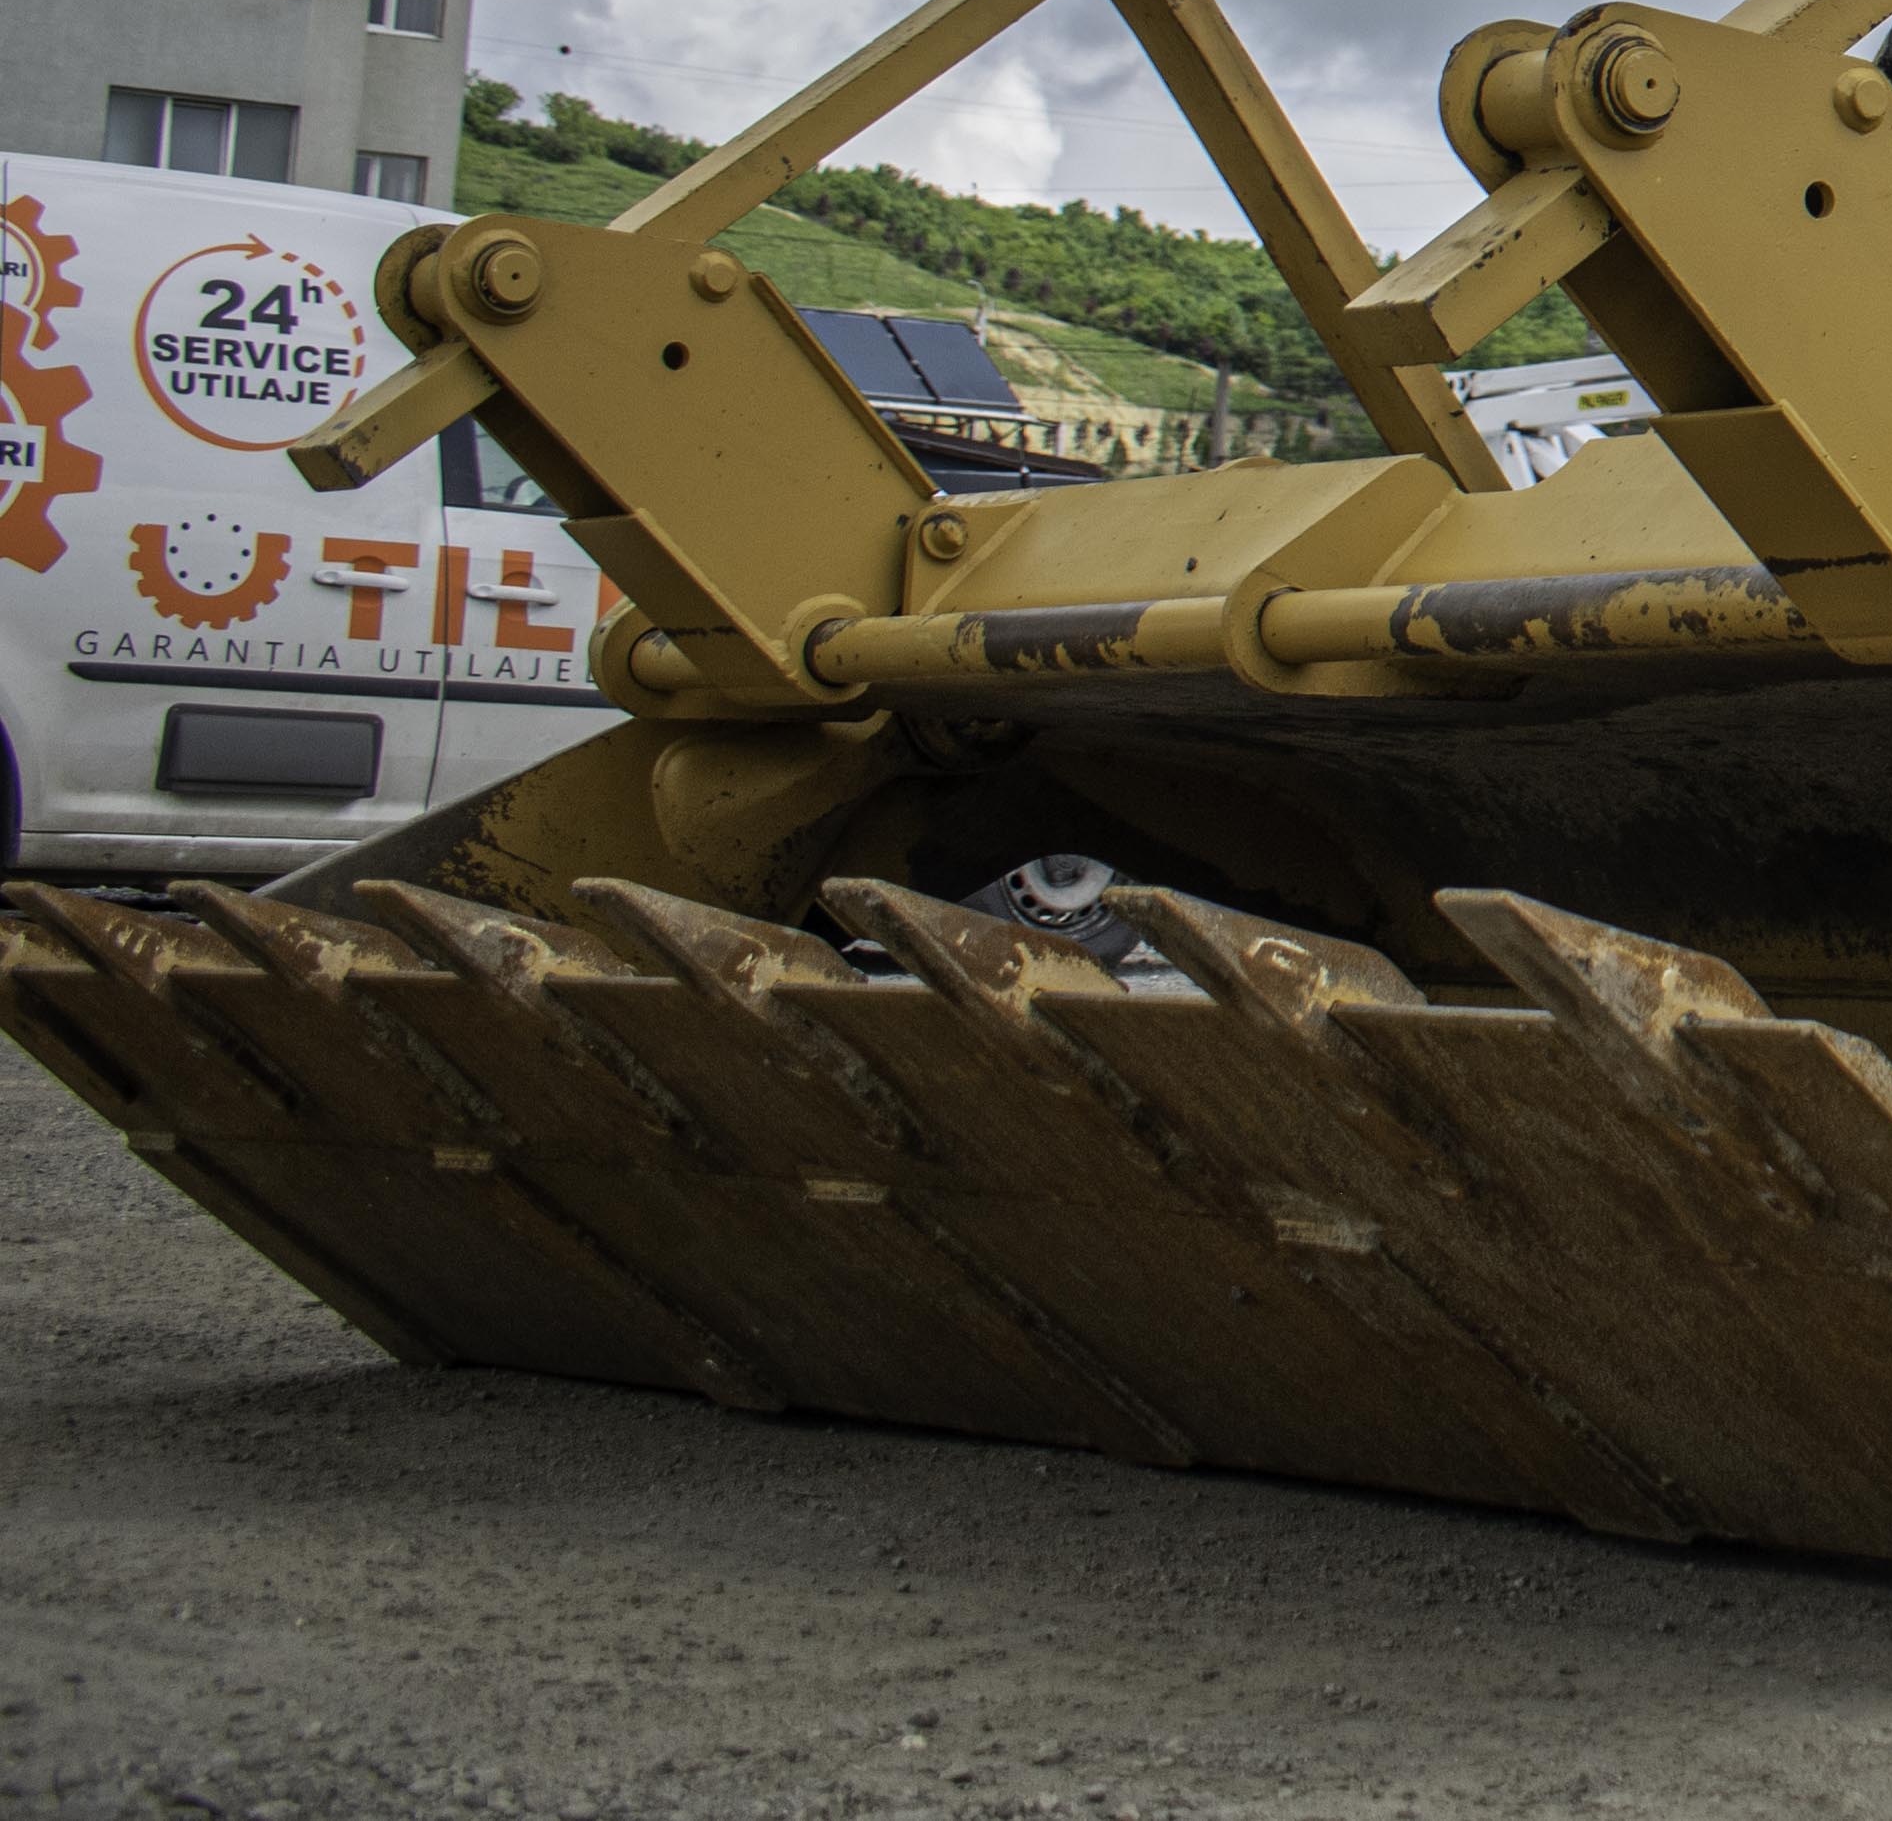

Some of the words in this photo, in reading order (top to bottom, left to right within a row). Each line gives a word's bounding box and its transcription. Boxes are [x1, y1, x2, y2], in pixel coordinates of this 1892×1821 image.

[0, 261, 28, 277] RI
[153, 333, 351, 376] SERVICE
[171, 370, 331, 405] UTILAJE
[129, 522, 624, 653] UTIL
